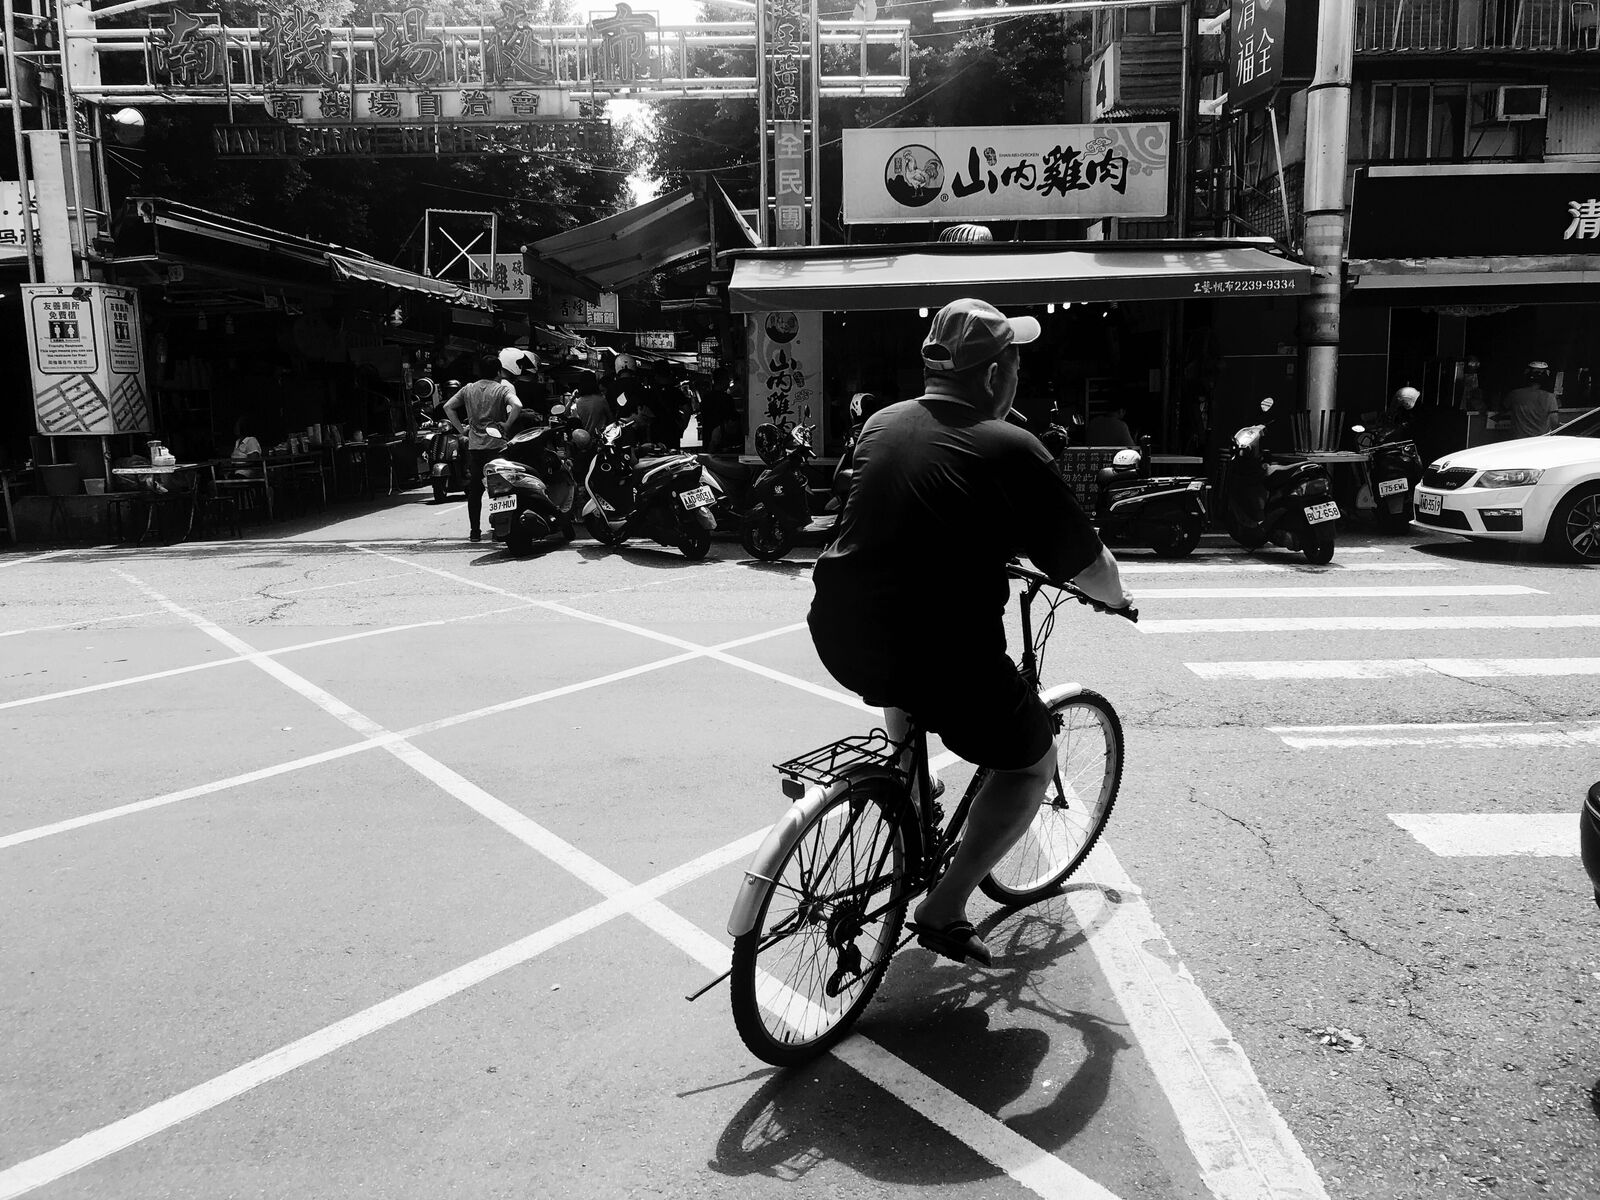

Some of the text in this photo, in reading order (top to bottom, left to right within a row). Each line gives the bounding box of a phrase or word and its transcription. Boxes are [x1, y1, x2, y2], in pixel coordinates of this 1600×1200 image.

[151, 3, 657, 84] 南機場夜市
[270, 90, 541, 119] 南機場自治會
[777, 132, 803, 246] 全民團
[489, 498, 516, 512] 387-HUV
[1306, 507, 1339, 522] BLZ-658
